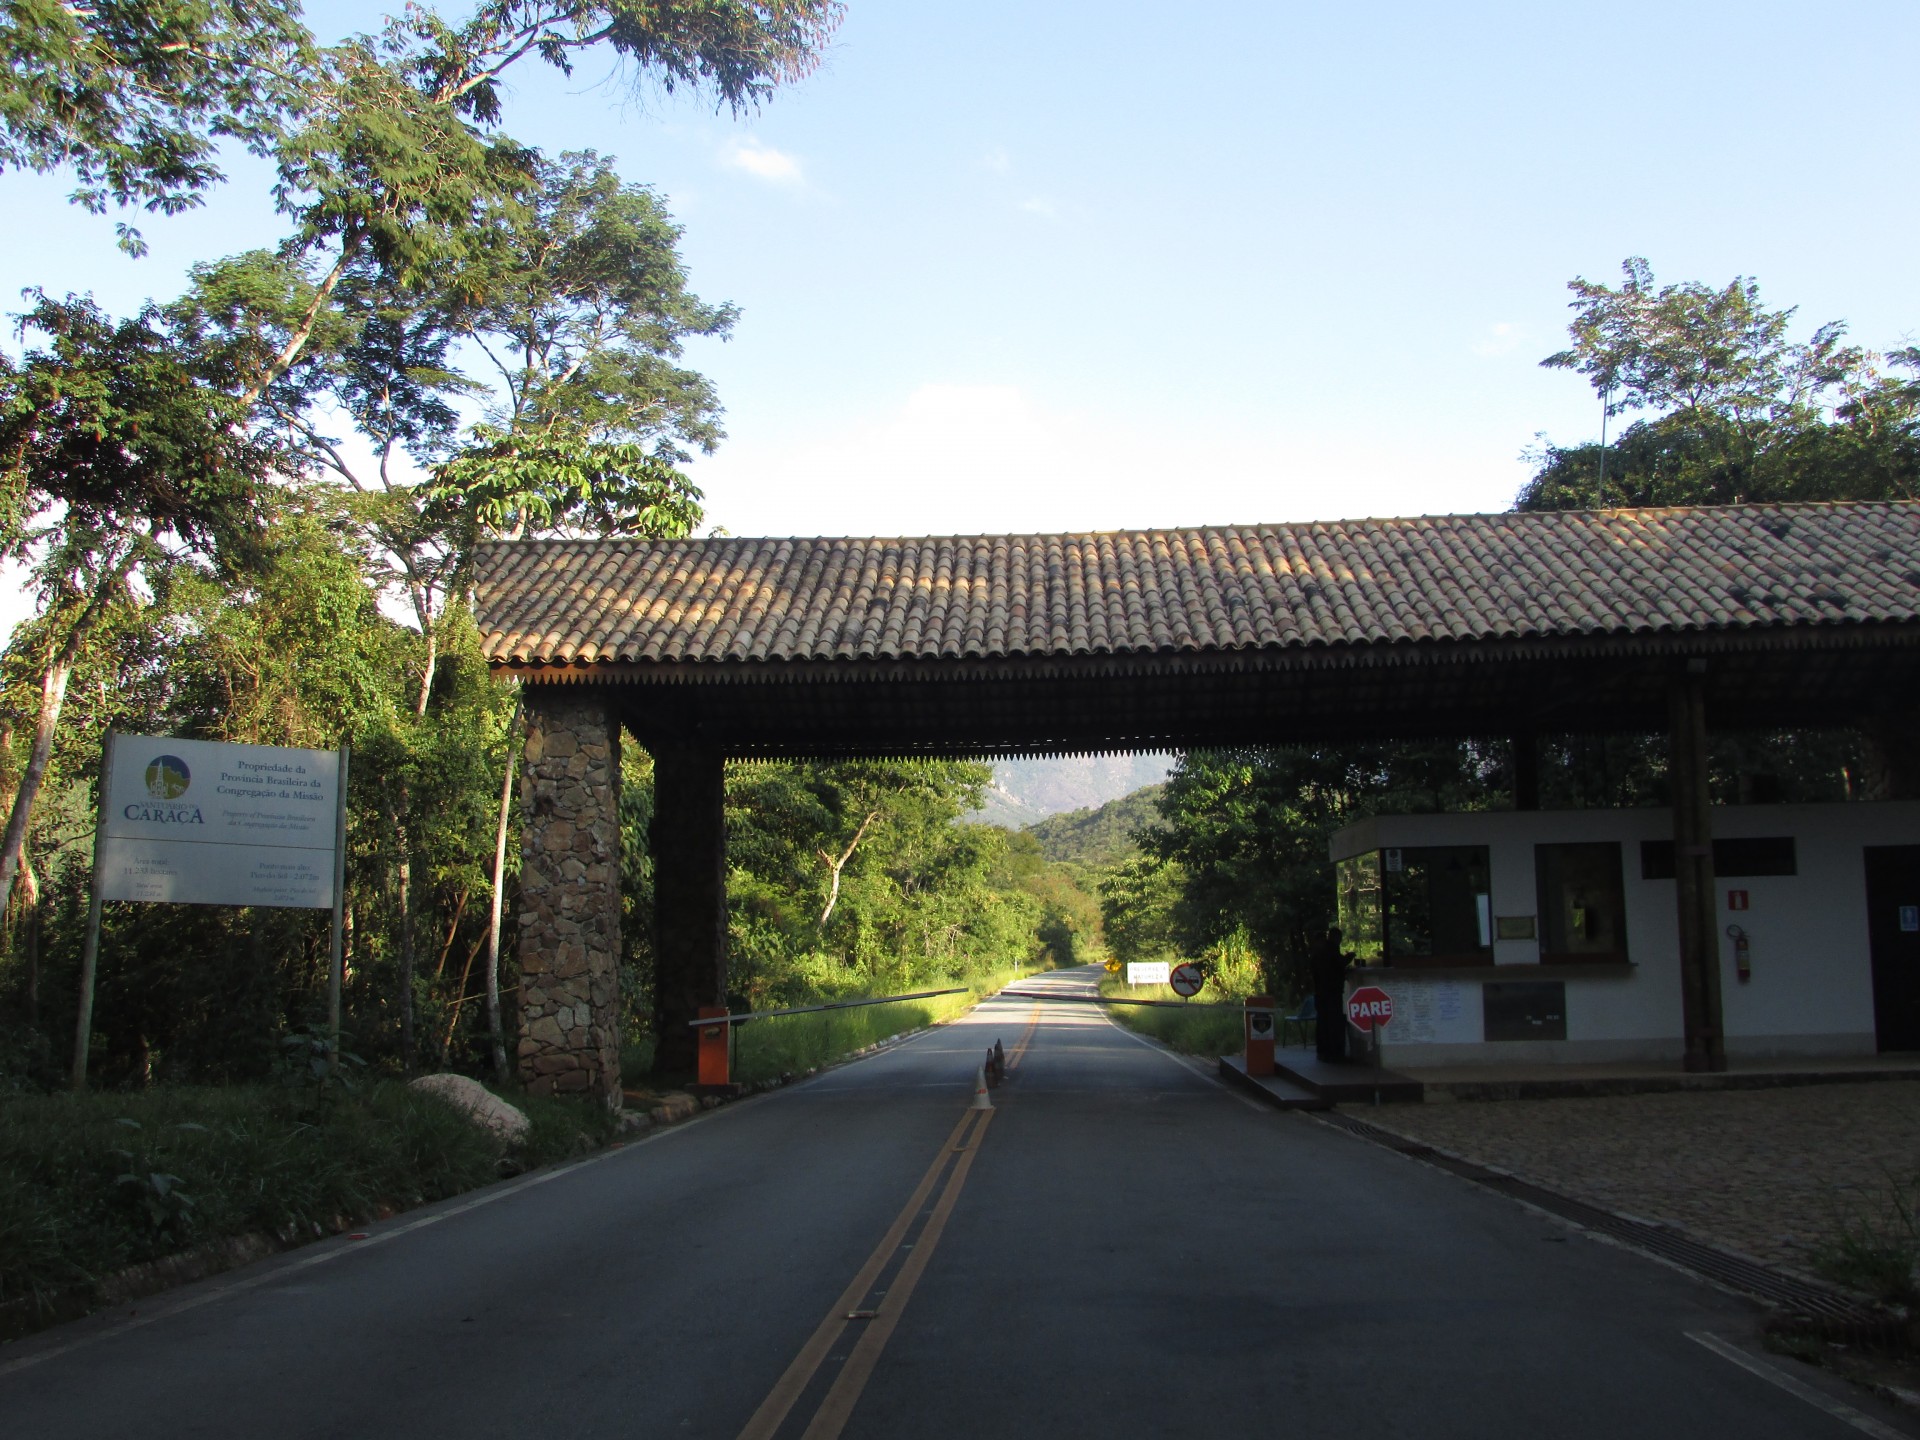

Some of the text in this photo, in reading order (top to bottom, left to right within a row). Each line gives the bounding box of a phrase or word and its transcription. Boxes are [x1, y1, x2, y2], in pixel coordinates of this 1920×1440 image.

[238, 761, 306, 774] Propriedade da
[221, 772, 321, 788] Província Brasileira da
[217, 785, 324, 801] Congregação da Missão
[124, 804, 205, 825] CARAÇA
[1350, 1000, 1392, 1018] PARE
